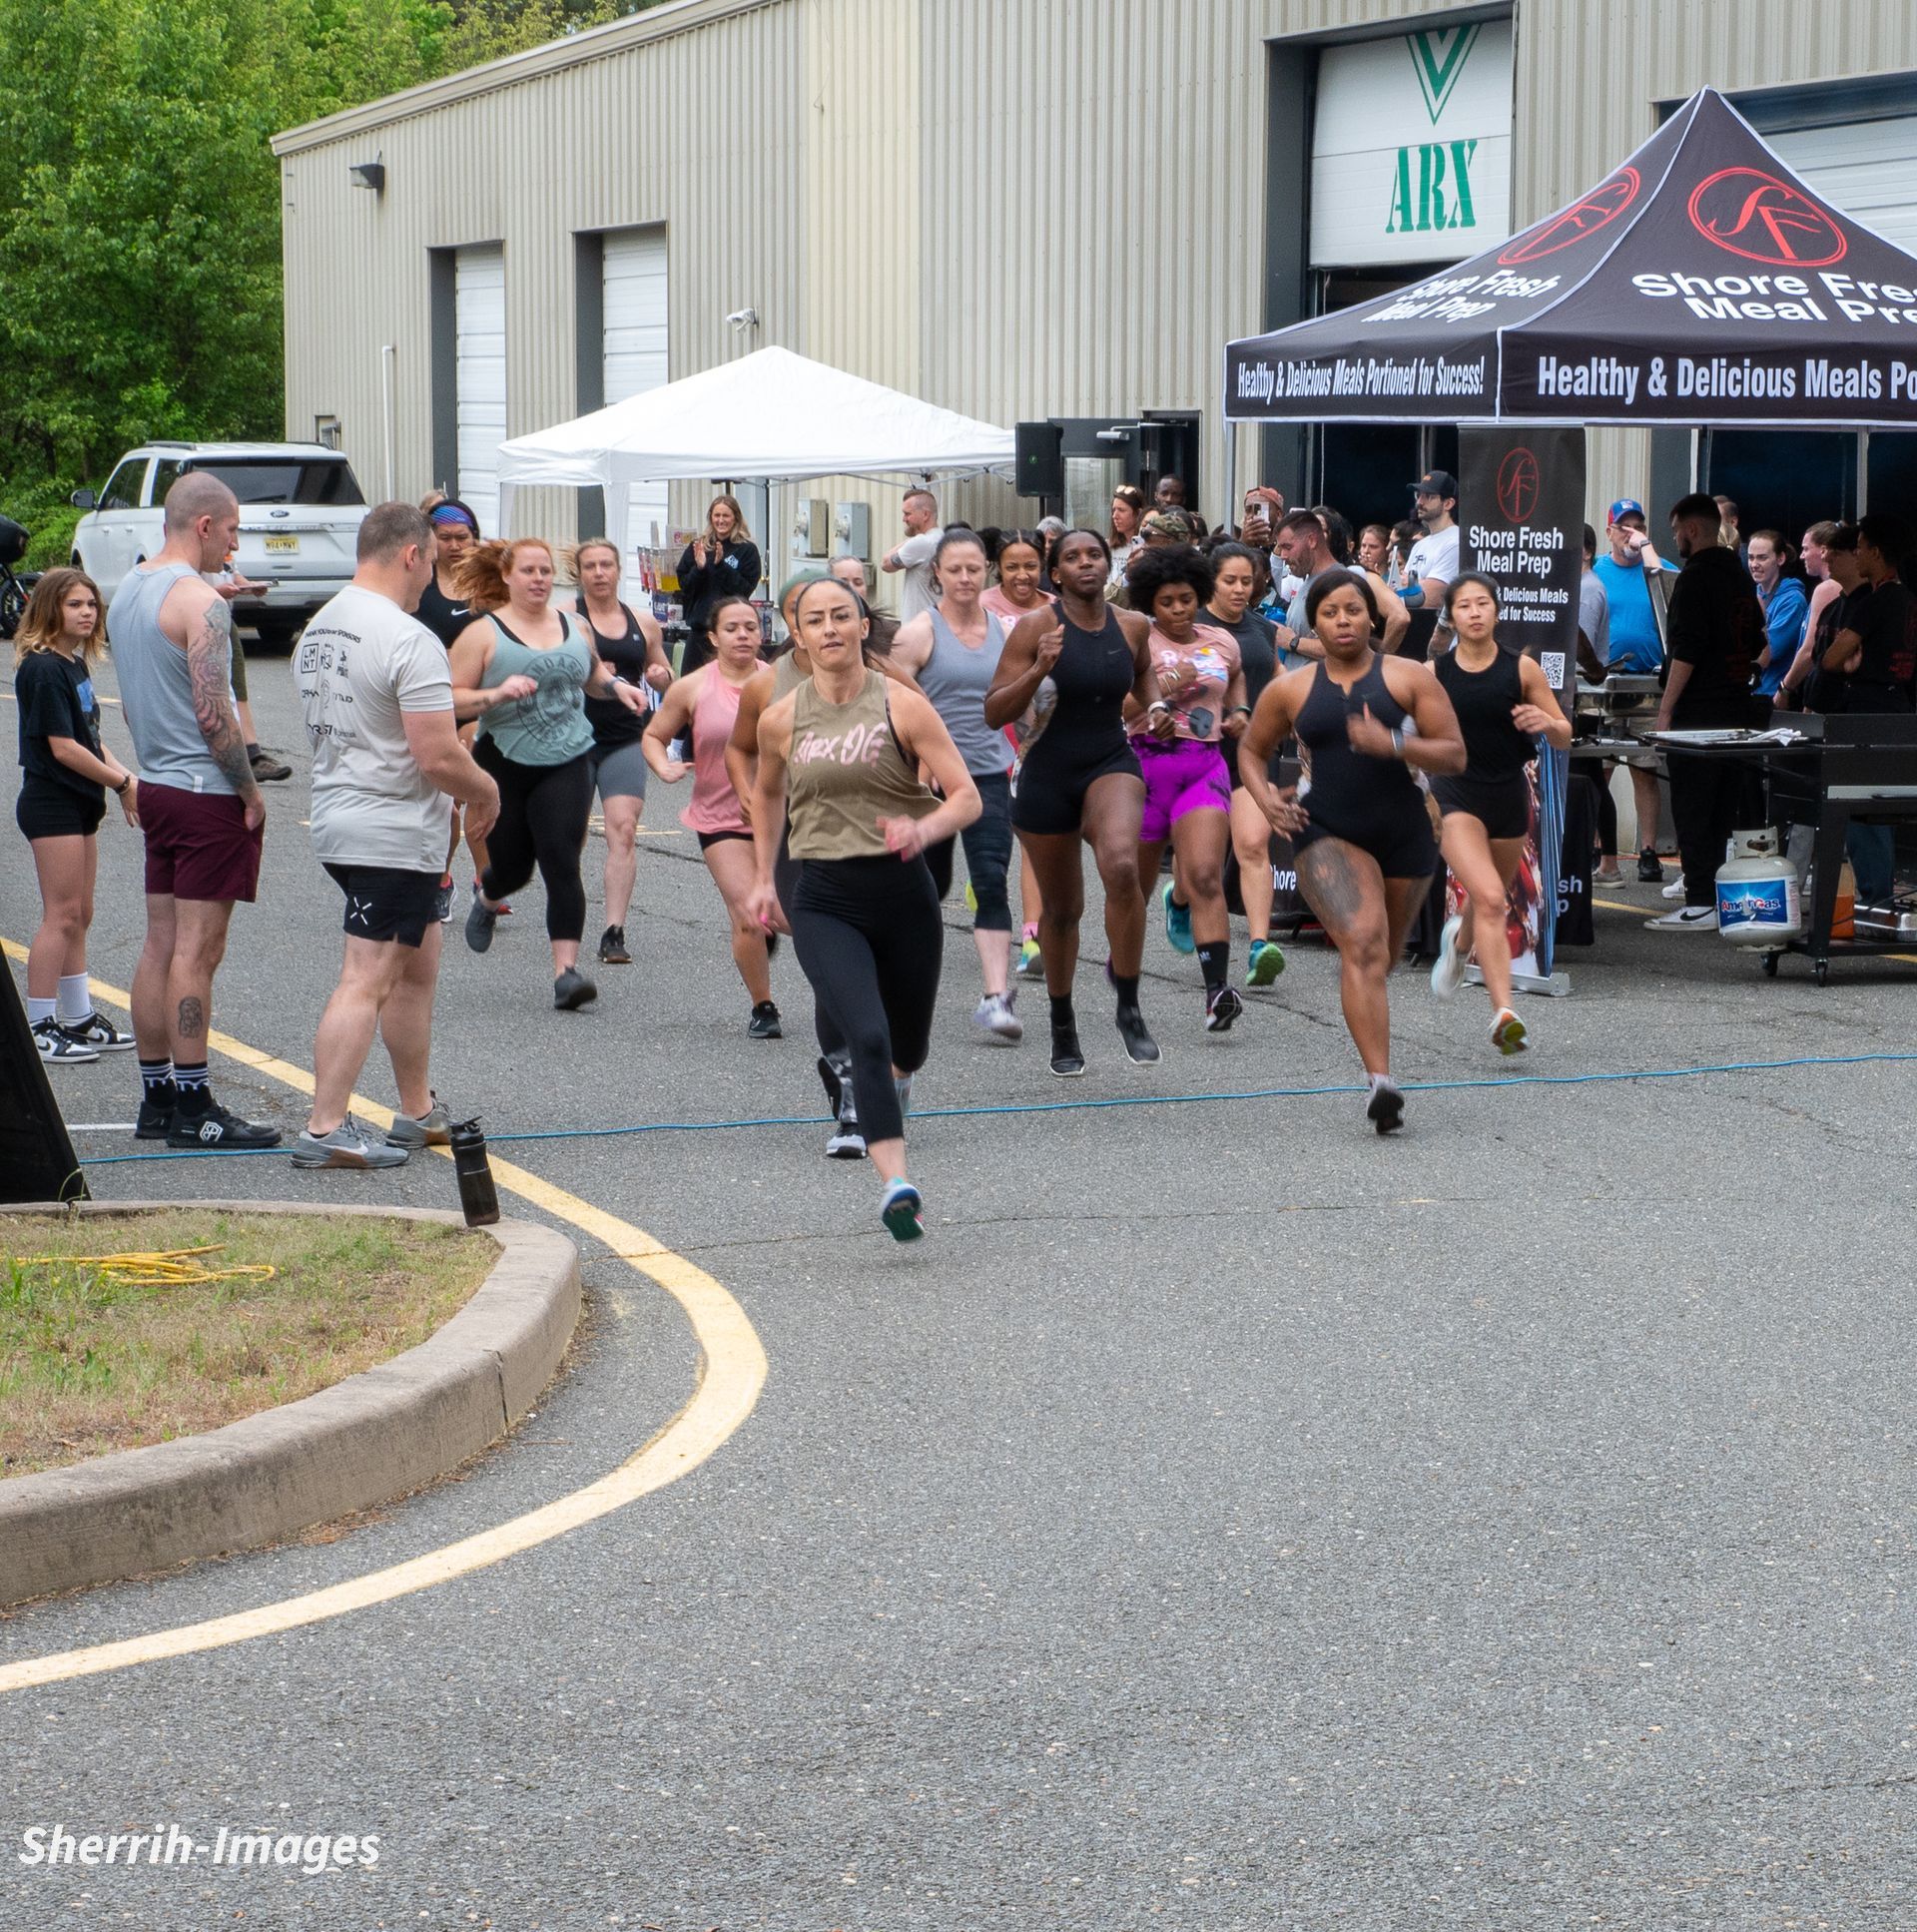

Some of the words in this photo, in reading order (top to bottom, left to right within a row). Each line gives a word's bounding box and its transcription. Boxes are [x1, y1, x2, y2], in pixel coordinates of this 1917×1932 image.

[1385, 139, 1478, 234] ARX
[1396, 276, 1481, 303] Shore
[1466, 269, 1562, 298] Fresh
[1631, 272, 1809, 297] Shore
[1817, 272, 1917, 304] Fre
[1361, 297, 1448, 322] Meal
[1435, 296, 1497, 323] Prep
[1683, 297, 1828, 322] Meal
[1237, 361, 1274, 405] Healthy
[1275, 360, 1285, 397] &
[1285, 359, 1332, 396] Delicious
[1333, 358, 1365, 396] Meals
[1365, 357, 1418, 395] Portioned
[1417, 356, 1435, 395] for
[1435, 354, 1486, 395] Success!
[1538, 355, 1640, 405] Healthy
[1647, 356, 1667, 397] &
[1676, 357, 1797, 398] Delicious
[1804, 358, 1882, 399] Meals
[1469, 525, 1516, 548] Shore
[1519, 526, 1565, 550] Fresh
[1477, 550, 1514, 573] Meal
[1517, 551, 1552, 579] Prep
[1503, 586, 1539, 603] Delicious
[1539, 587, 1569, 604] Meals
[1510, 605, 1521, 621] for
[1523, 605, 1556, 622] Success
[1270, 864, 1297, 891] hore
